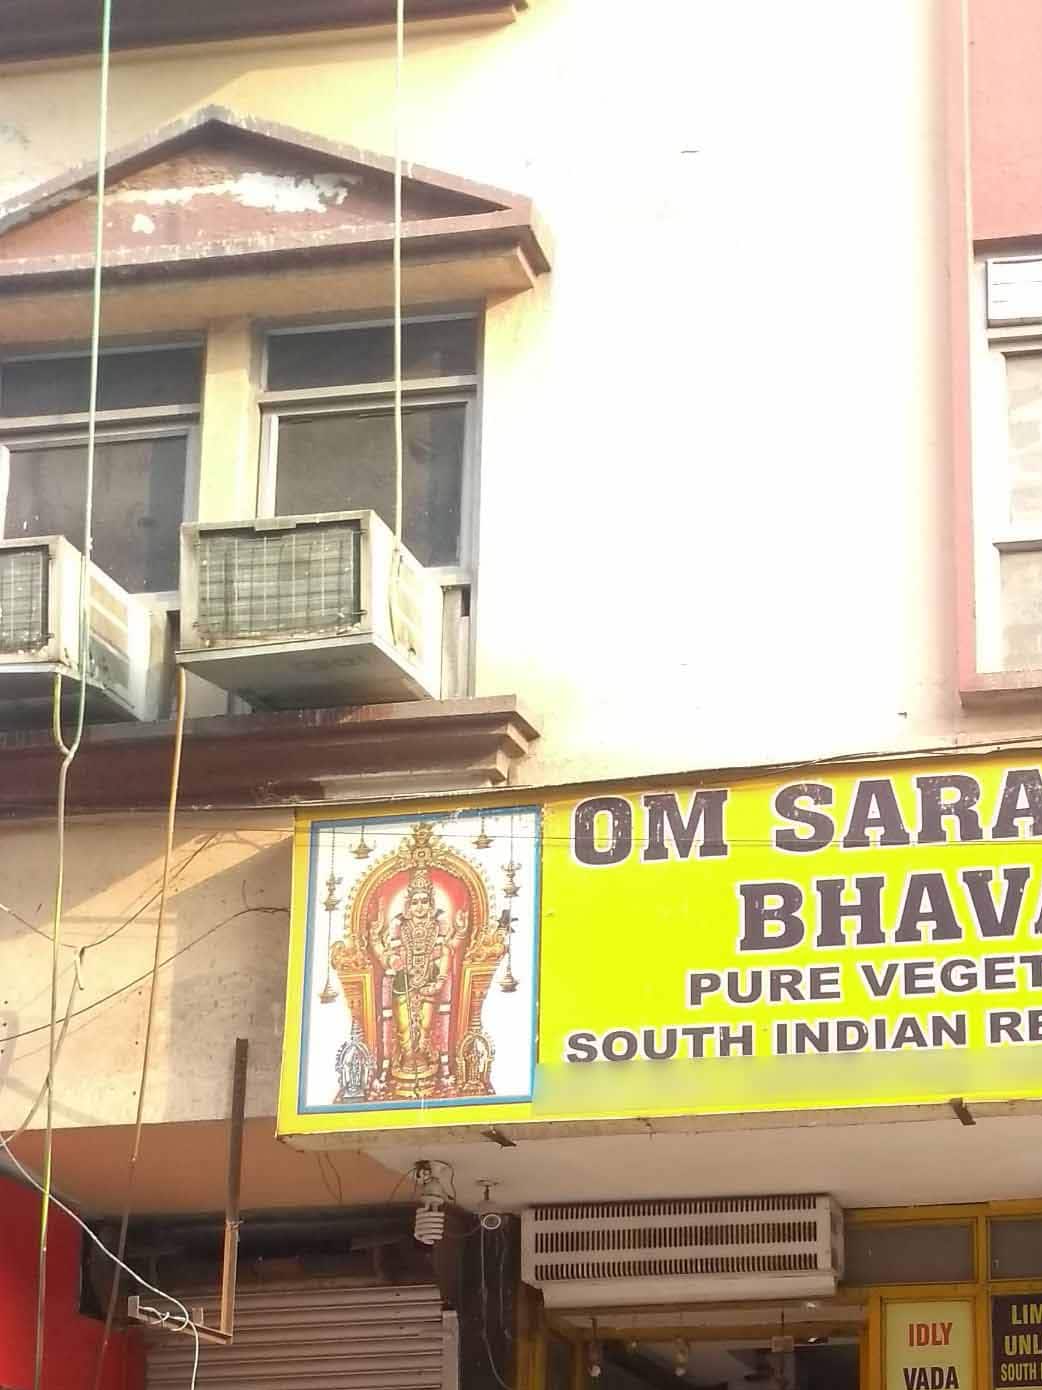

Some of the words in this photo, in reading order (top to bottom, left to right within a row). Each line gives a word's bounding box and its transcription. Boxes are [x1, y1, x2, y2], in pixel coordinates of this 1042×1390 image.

[570, 786, 728, 866] OM
[687, 964, 842, 1006] PURE
[566, 1025, 754, 1064] SOUTH
[773, 1013, 969, 1056] INDIAN
[908, 1322, 952, 1347] IDLY
[903, 1366, 959, 1390] VADA
[1000, 1362, 1037, 1381] SOUTH
